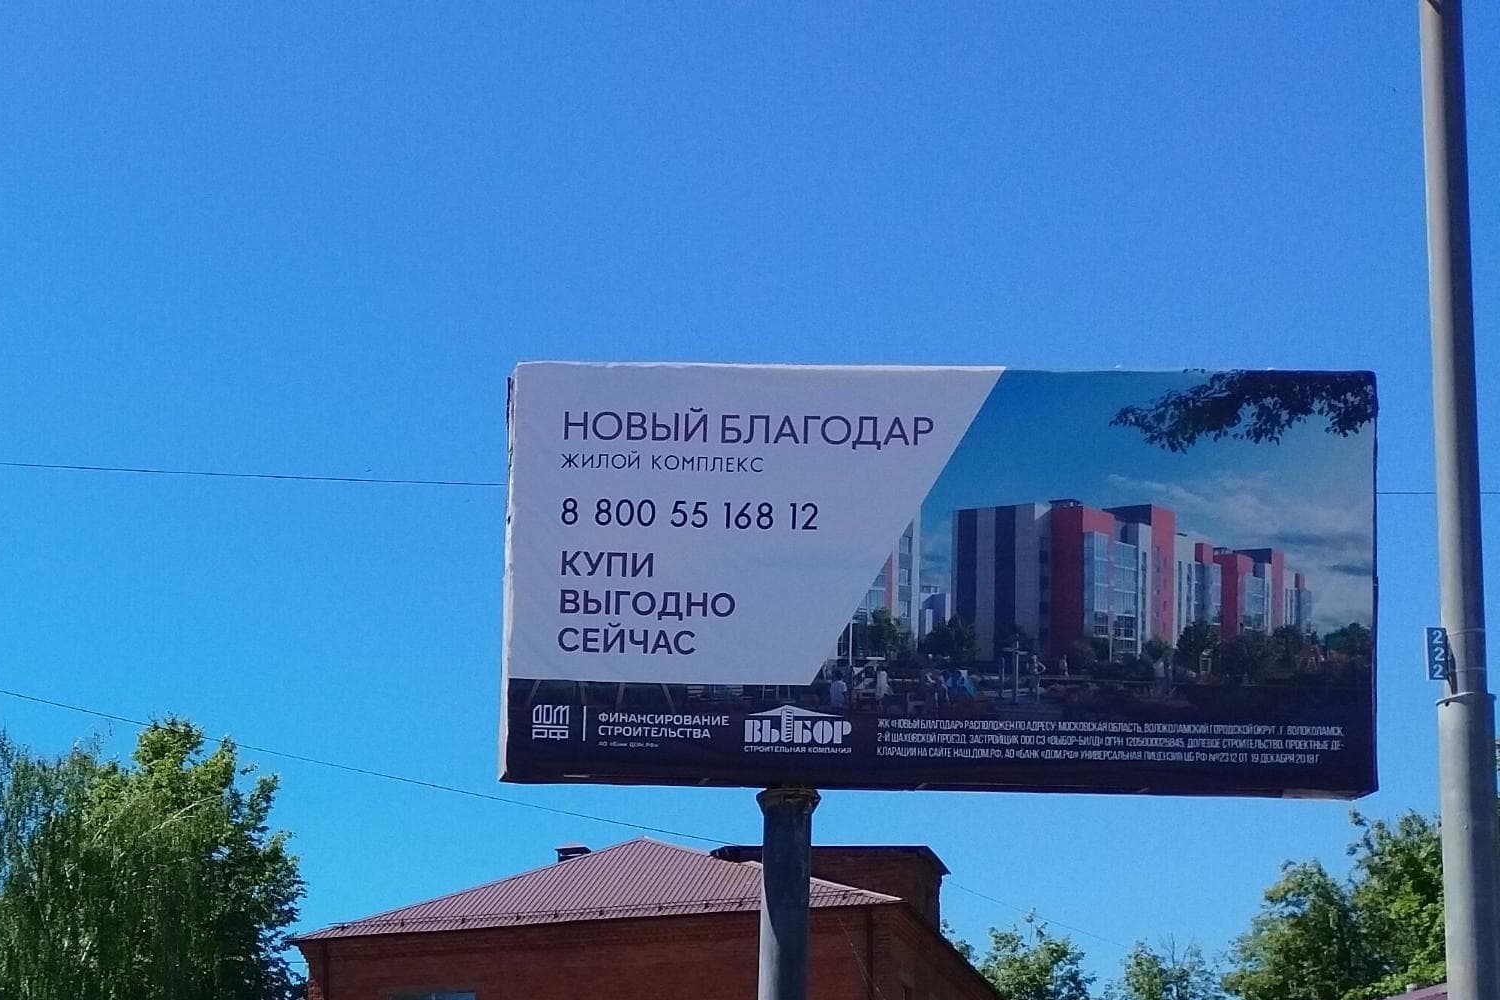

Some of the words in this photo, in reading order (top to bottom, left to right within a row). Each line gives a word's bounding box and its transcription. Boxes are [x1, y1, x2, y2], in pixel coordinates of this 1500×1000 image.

[562, 407, 709, 443] НОВЫЙ
[720, 414, 935, 451] БЛАГОДАР
[560, 451, 641, 471] ЖИЛОЙ
[651, 454, 765, 474] КОМПЛЕКС
[560, 497, 579, 526] 8
[594, 498, 657, 528] 800
[670, 500, 709, 529] 55
[723, 501, 775, 531] 168
[789, 501, 819, 531] 12
[560, 550, 655, 578] КУПИ
[559, 589, 737, 622] ВЫГОДНО
[557, 622, 697, 656] СЕЙЧАС
[532, 704, 570, 725] ДОМ
[597, 711, 731, 726] ФИНАНСИРОВАНИЕ
[597, 725, 711, 740] СТРОИТЕЛЬСТВА
[744, 709, 852, 744] ВЫБОР
[877, 718, 890, 729] ЖК
[890, 717, 920, 730] «НОВЫЙ
[921, 719, 963, 731] БЛАГОДАР»
[964, 720, 1015, 731] РАСПОЛОЖЕН
[1015, 720, 1027, 731] ПО
[1058, 721, 1107, 733] МОСКОВСКАЯ
[1143, 722, 1210, 735] ВОЛОКОЛАМСКИЙ
[1210, 723, 1254, 736] ГОРОДСКОЙ
[743, 745, 807, 754] СТРОИТЕЛЬНАЯ
[807, 746, 853, 755] КОМПАНИЯ
[969, 733, 1019, 746] ЗАСТРОЙЩИК
[1020, 735, 1035, 746] ООО
[1036, 735, 1046, 746] СЗ
[1104, 736, 1124, 747] ОГРН
[1187, 738, 1220, 749] ДОЛЕВОЕ
[1285, 739, 1329, 751] ПРОЕКТНЫЕ
[876, 746, 917, 758] КЛАРАЦИИ
[917, 747, 928, 758] НА
[928, 746, 952, 758] САЙТЕ
[1005, 748, 1016, 759] АО
[1080, 750, 1143, 761] УНИВЕРСАЛЬНАЯ
[1143, 751, 1184, 762] ЛИЦЕНЗИЯ
[1184, 751, 1196, 762] ЦБ
[1195, 751, 1208, 762] РФ
[1238, 752, 1249, 763] ОТ
[1259, 753, 1295, 765] ДЕКАБРЯ
